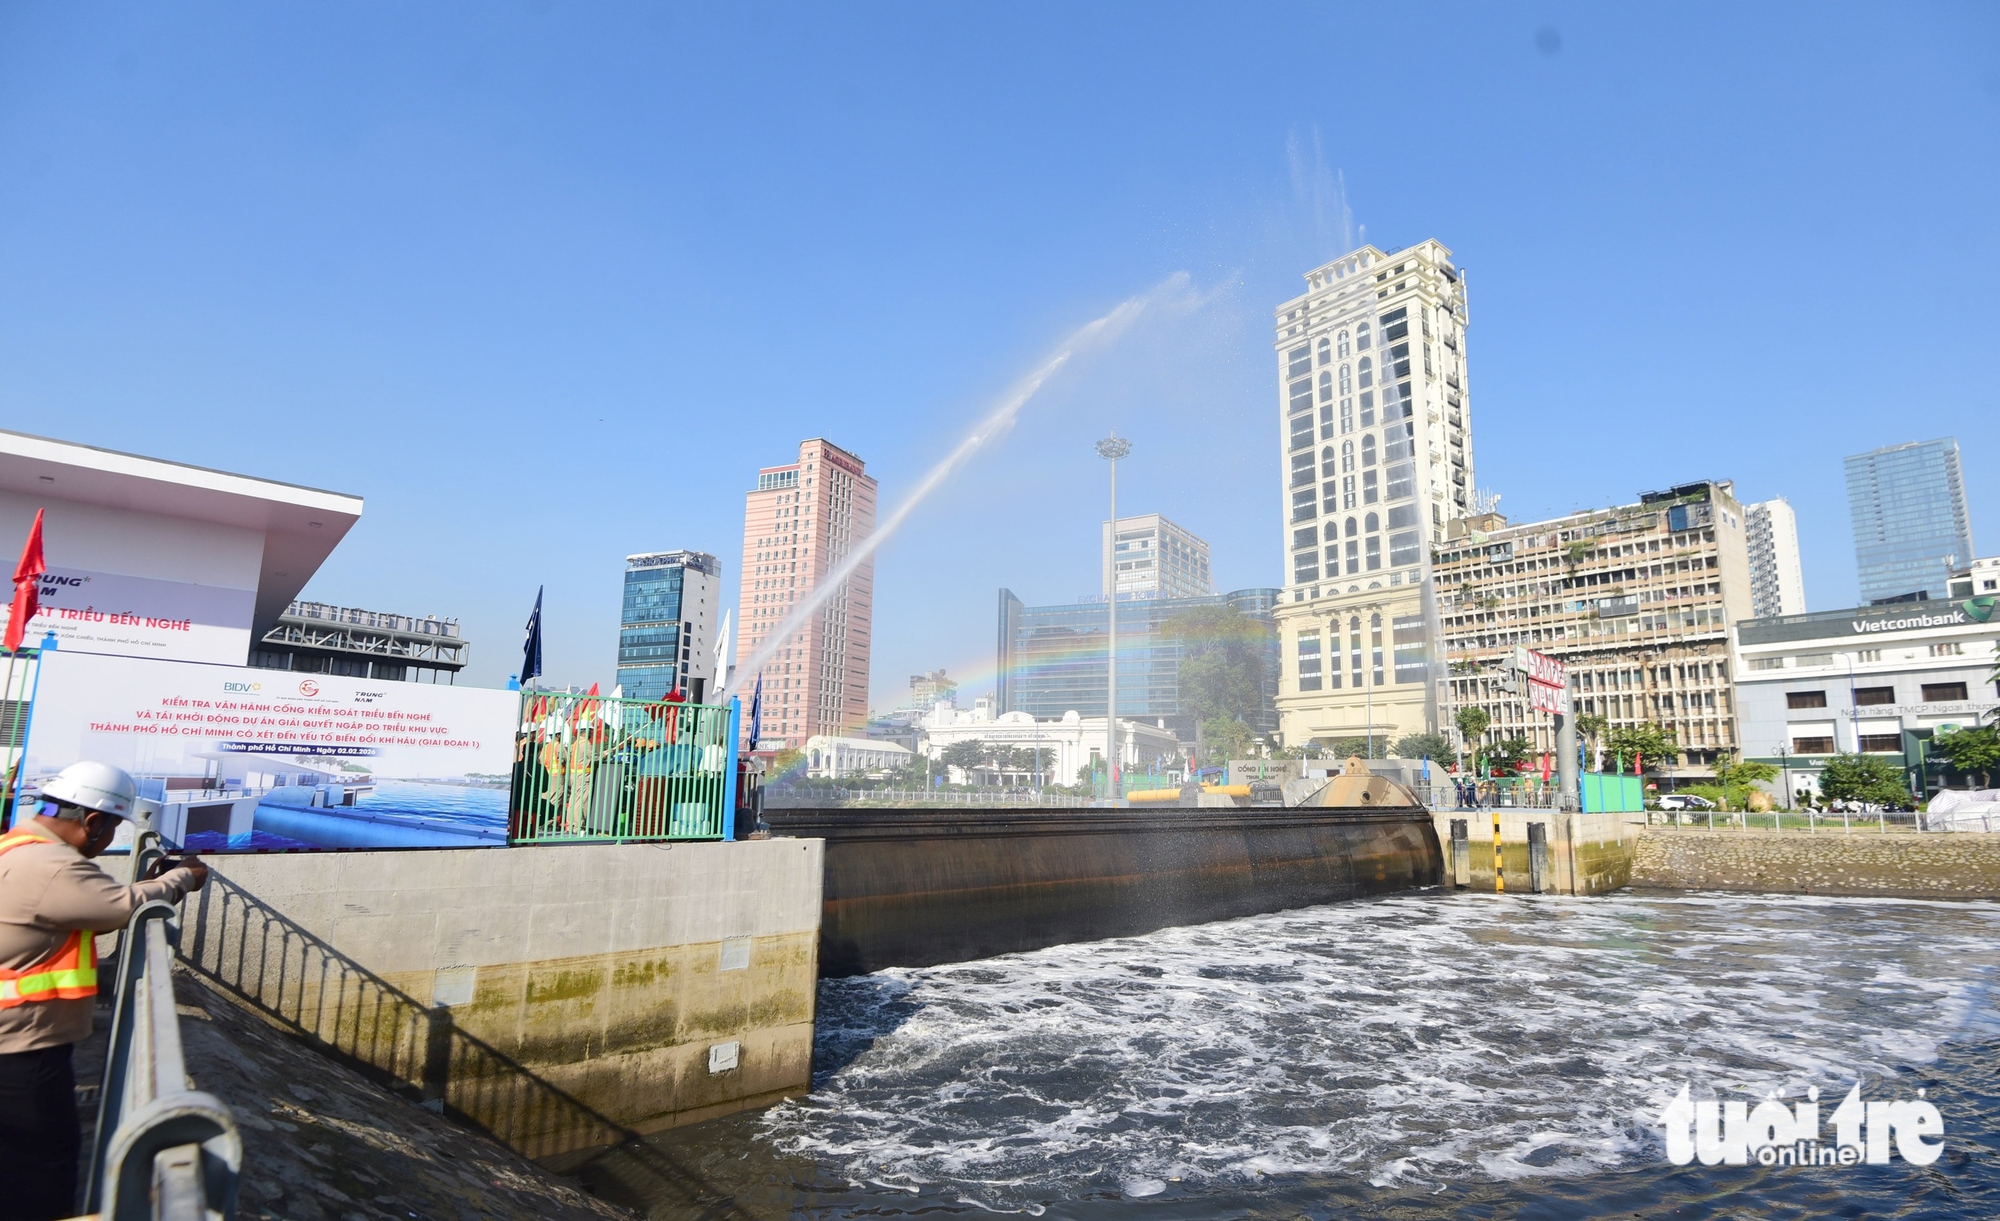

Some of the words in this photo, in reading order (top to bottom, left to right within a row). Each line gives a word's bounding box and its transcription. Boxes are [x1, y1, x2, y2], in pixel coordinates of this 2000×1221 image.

[60, 605, 104, 623] TRIỀU
[109, 611, 140, 626] BẾN
[146, 618, 191, 632] NGHÉ
[1852, 610, 1965, 633] Vietcombank
[224, 682, 252, 692] BIDV
[162, 695, 188, 707] KIỂM
[192, 700, 210, 709] TRA
[215, 701, 237, 711] VẬN
[240, 702, 270, 712] HÀNH
[273, 703, 304, 714] CỐNG
[308, 705, 331, 716] KIỂM
[334, 708, 358, 717] SOÁT
[361, 709, 385, 719] TRIỀU
[387, 710, 404, 720] BẾN
[406, 712, 432, 721] NGHÉ
[1897, 705, 1929, 714] TMCP
[136, 709, 152, 719] VÀ
[156, 710, 172, 720] TÁI
[176, 712, 204, 722] KHỞI
[207, 713, 239, 725] ĐỘNG
[243, 716, 258, 726] DỰ
[260, 716, 275, 726] ÁN
[278, 717, 300, 727] GIẢI
[302, 719, 333, 730] QUYẾT
[336, 721, 363, 731] NGẬP
[383, 722, 406, 732] TRIỀU
[429, 726, 448, 735] VỰC
[90, 722, 129, 732] THÀNH
[133, 723, 158, 734] PHỐ
[161, 723, 178, 735] HỒ
[181, 726, 202, 736] CHÍ
[205, 729, 233, 738] MINH
[236, 729, 253, 738] CÓ
[257, 729, 274, 739] XÉT
[277, 730, 297, 740] ĐẾN
[300, 730, 317, 741] YẾU
[320, 731, 333, 742] TỐ
[335, 732, 356, 742] BIẾN
[359, 733, 376, 743] ĐỔI
[379, 735, 395, 745] KHÍ
[397, 736, 416, 746] HẬU
[418, 738, 441, 747] (GIAI
[443, 739, 469, 748] ĐOẠN
[472, 740, 481, 749] 1)
[223, 743, 246, 751] Thành
[248, 744, 265, 752] phố
[265, 744, 277, 752] Hồ
[317, 747, 337, 755] Ngày
[337, 747, 376, 755] 02.02.2026
